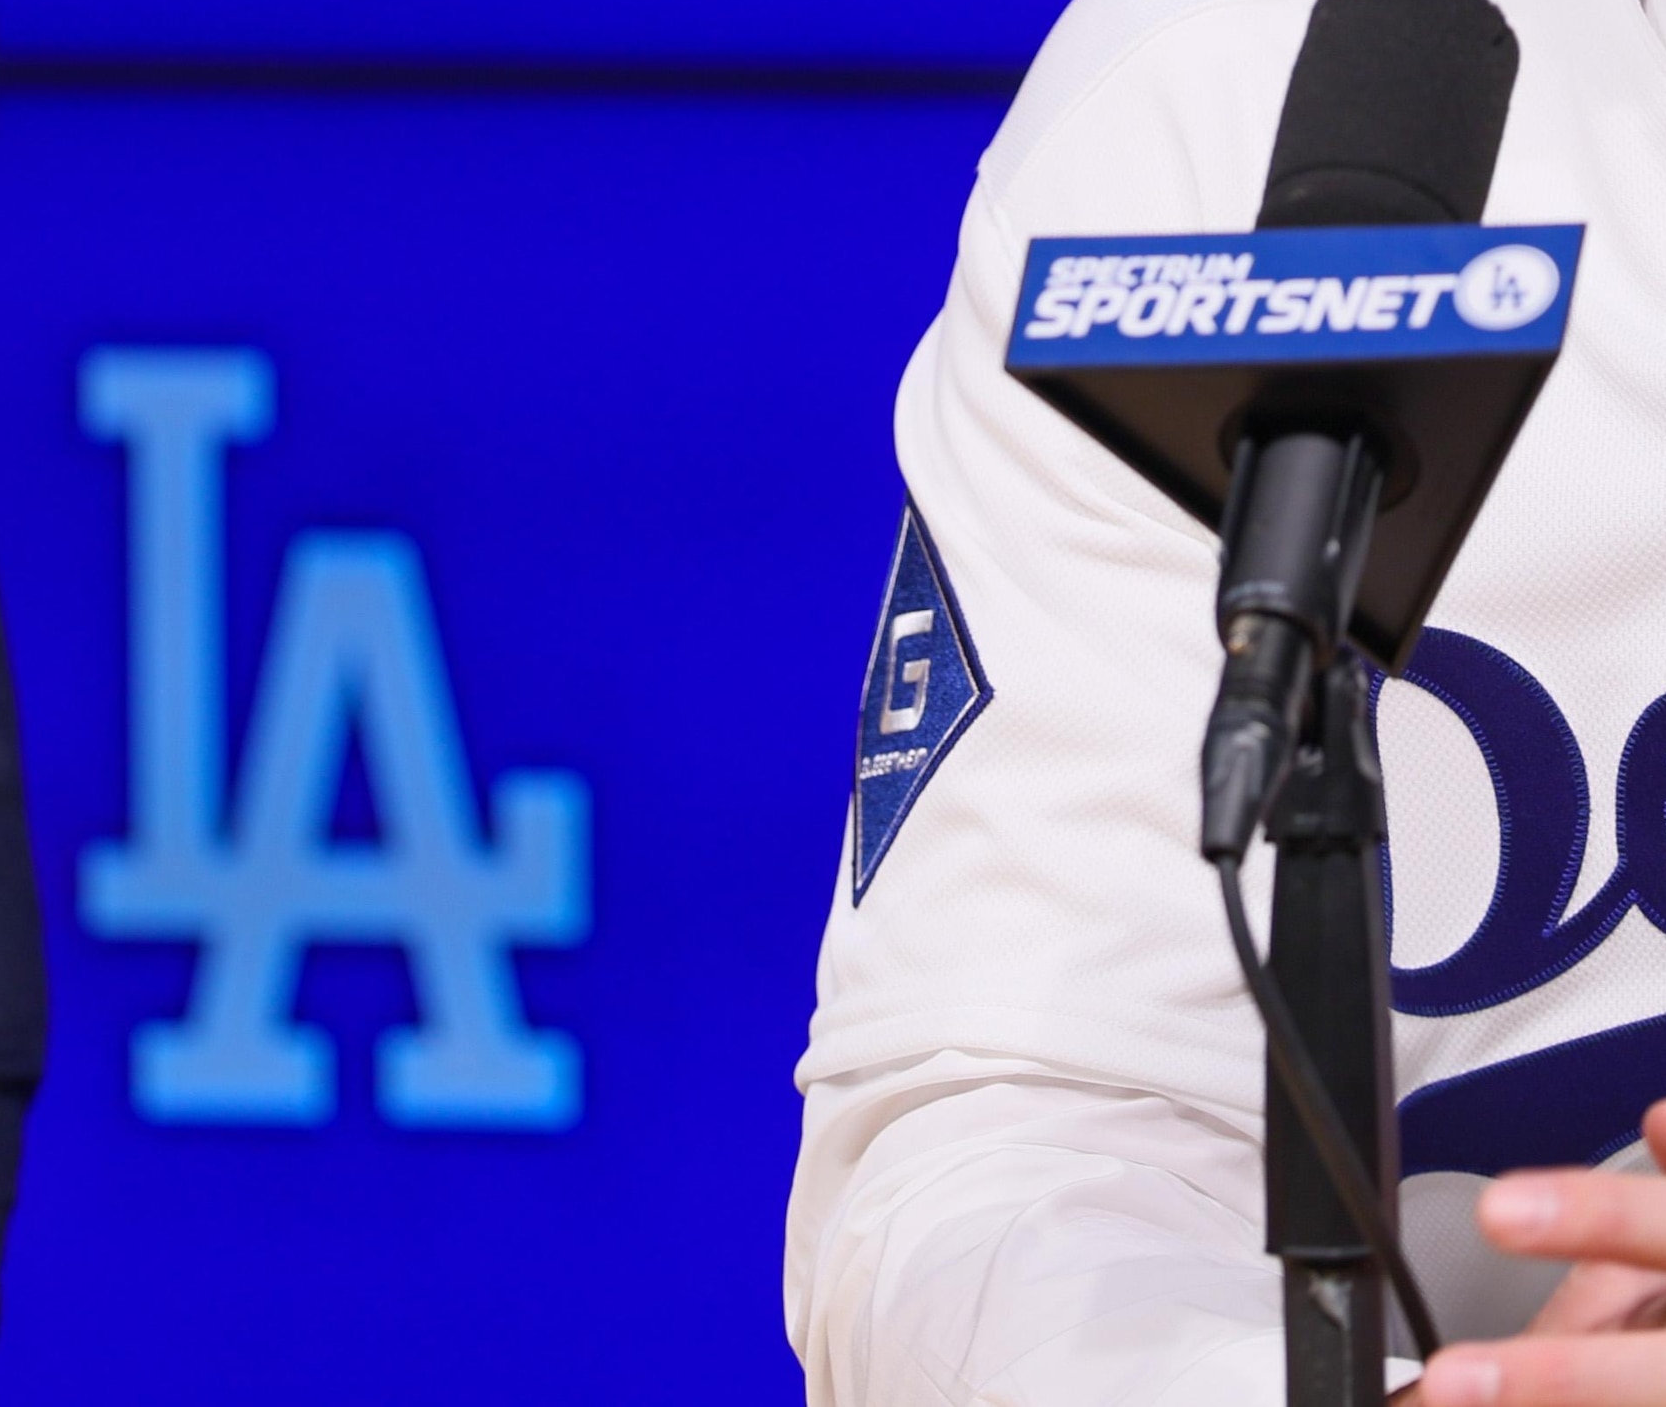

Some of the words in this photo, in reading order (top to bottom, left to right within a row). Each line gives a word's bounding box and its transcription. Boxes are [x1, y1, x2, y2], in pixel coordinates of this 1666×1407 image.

[1024, 271, 1461, 340] SPORTSNET
[1044, 251, 1255, 289] SPECTRUM
[878, 609, 934, 735] G
[78, 344, 595, 1132] LA
